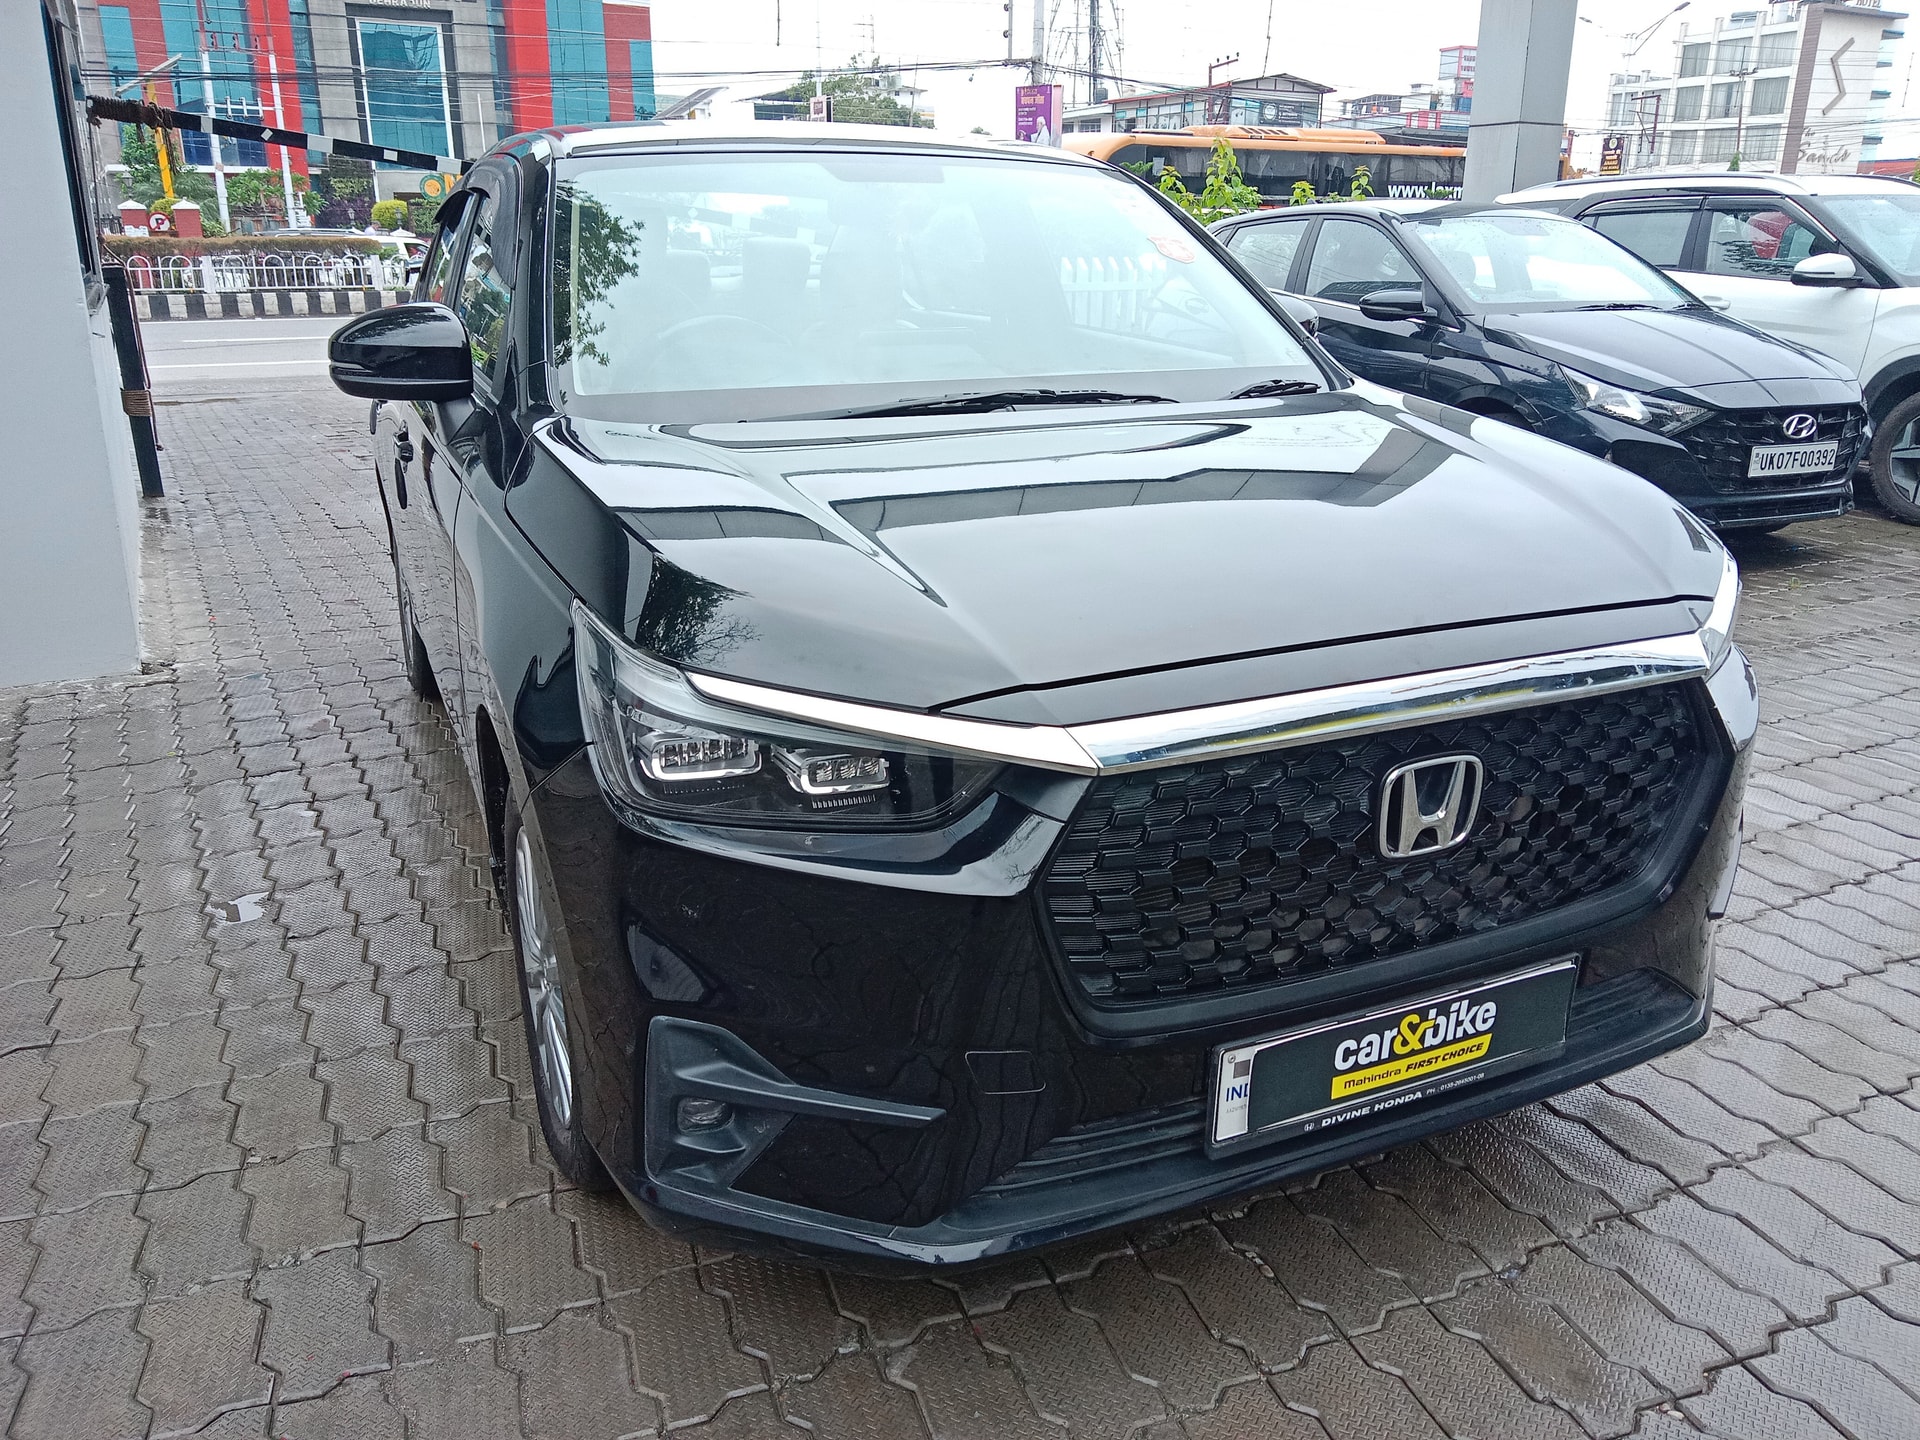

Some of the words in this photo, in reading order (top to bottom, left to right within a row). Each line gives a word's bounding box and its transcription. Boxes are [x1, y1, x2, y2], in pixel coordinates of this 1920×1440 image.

[1334, 1000, 1497, 1071] car&bike
[1344, 1068, 1401, 1089] Mahindra
[1405, 1056, 1441, 1072] FIRST
[1442, 1042, 1484, 1061] CHOICE
[1321, 1106, 1370, 1127] DIVINE
[1374, 1091, 1422, 1112] HONDA
